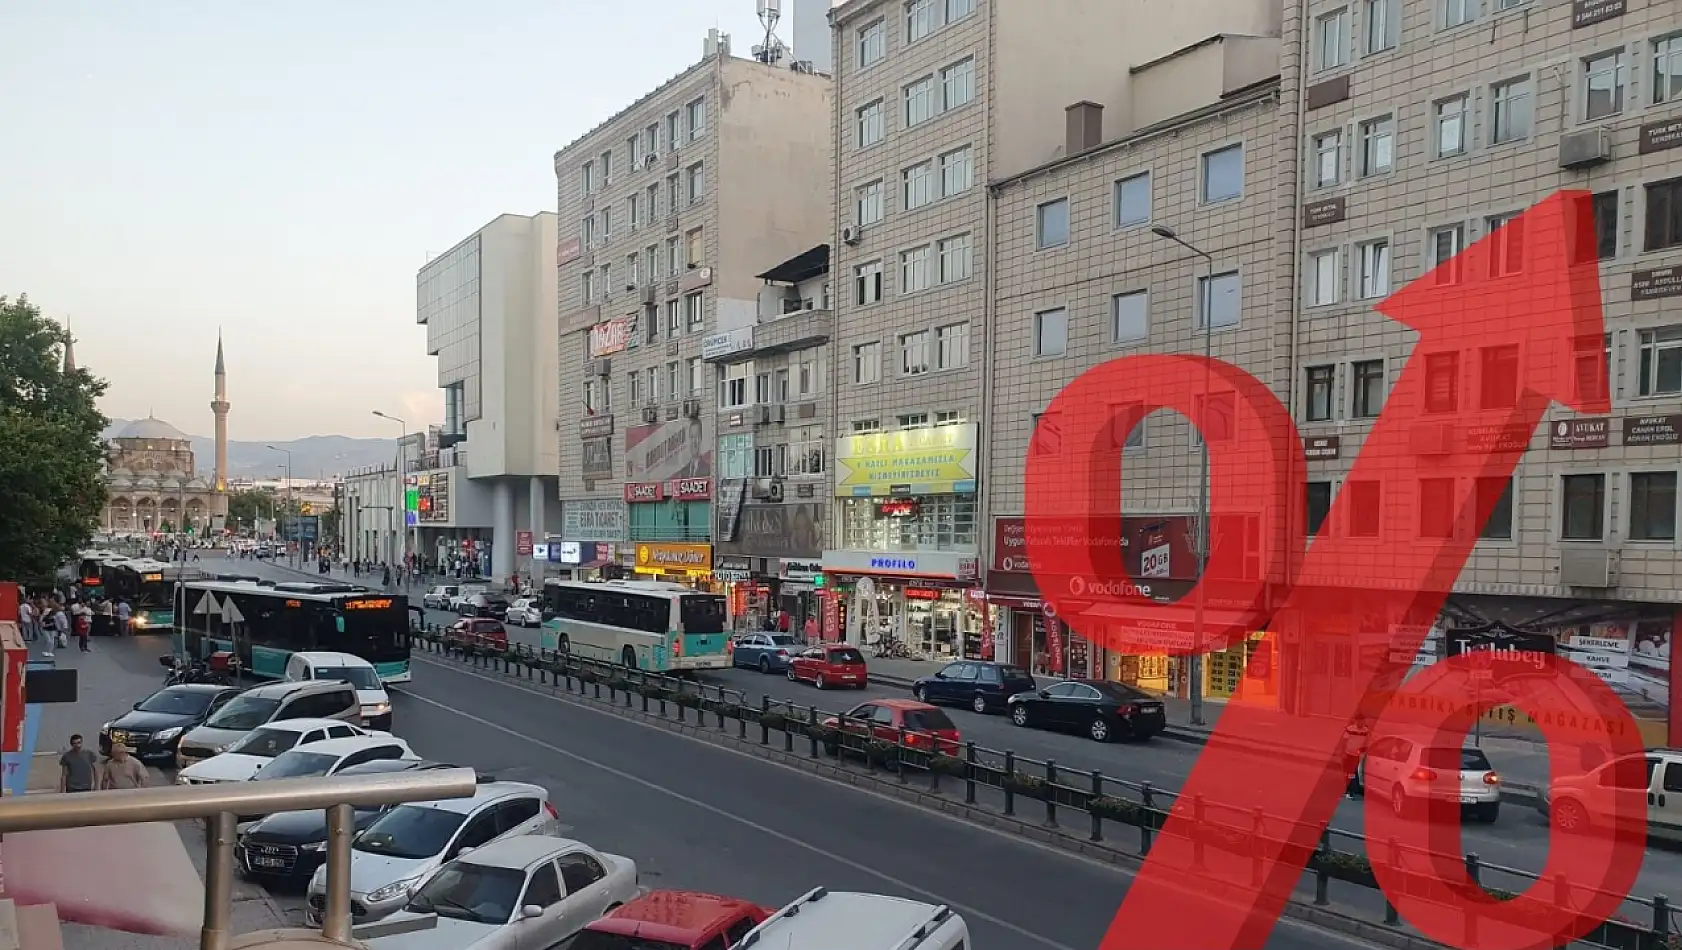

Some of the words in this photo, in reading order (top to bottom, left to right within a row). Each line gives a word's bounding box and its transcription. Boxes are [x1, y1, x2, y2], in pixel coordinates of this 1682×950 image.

[1575, 422, 1605, 433] AVUKAT
[680, 481, 708, 494] SAADET
[1143, 553, 1157, 574] 20
[1088, 580, 1152, 597] vodafone
[1586, 655, 1611, 664] KAHVE
[1389, 695, 1456, 714] FABRİKA
[1527, 709, 1625, 736] MAĞAZASI
